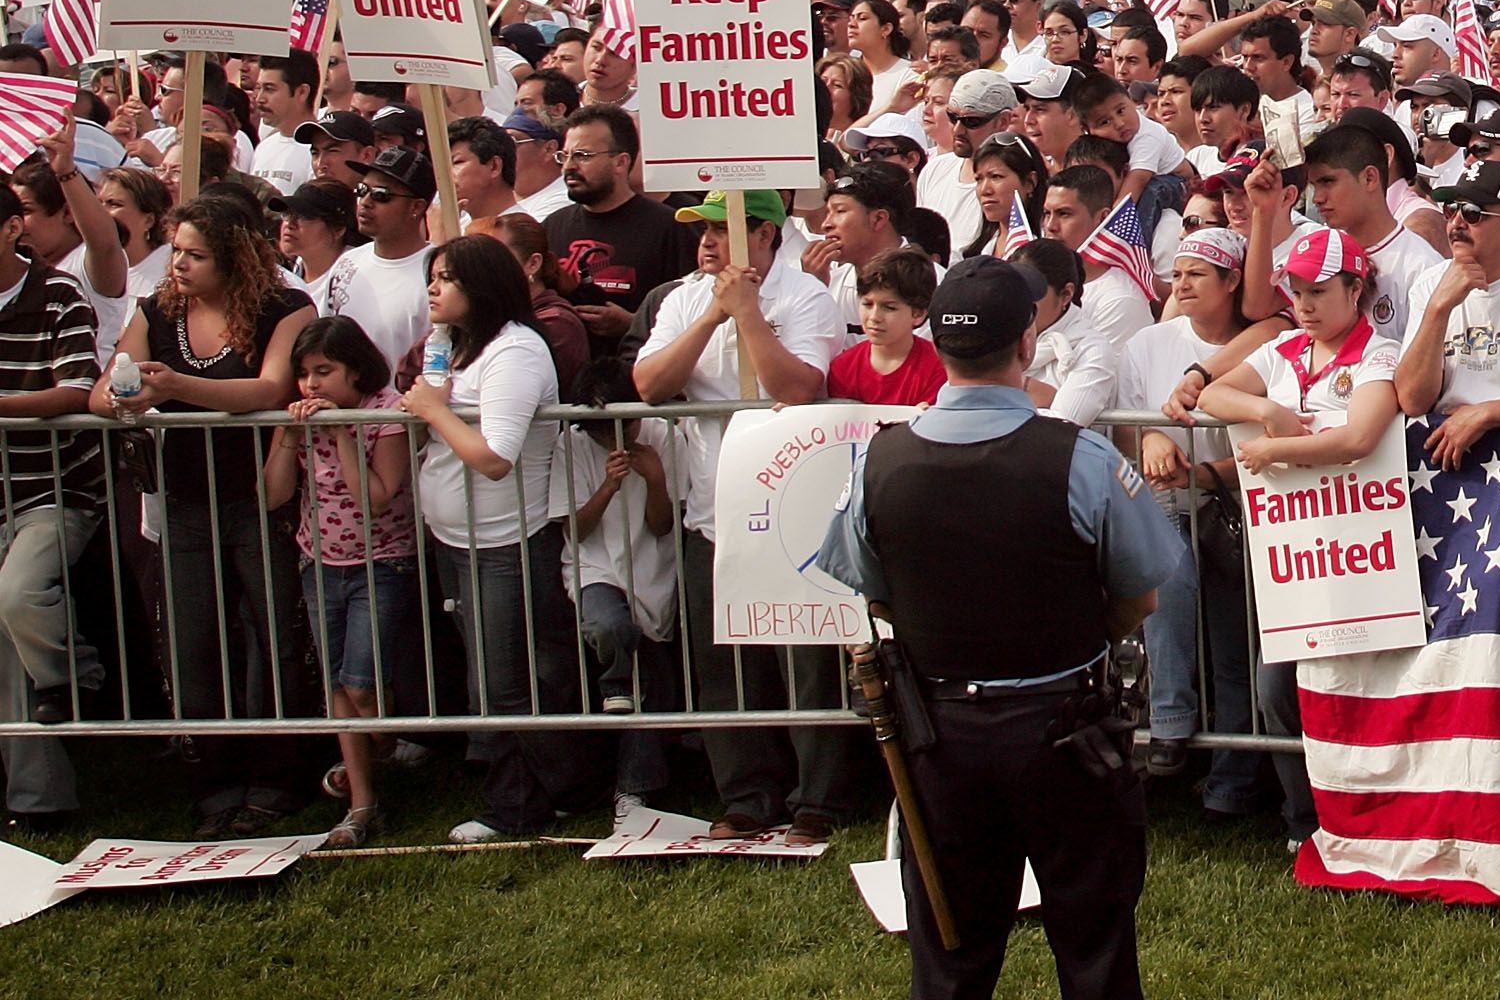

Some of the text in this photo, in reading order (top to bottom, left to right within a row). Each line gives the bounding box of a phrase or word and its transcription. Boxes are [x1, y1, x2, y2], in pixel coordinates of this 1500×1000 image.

[639, 20, 809, 63] Families
[660, 78, 795, 119] United
[942, 313, 978, 325] CPD
[748, 420, 879, 532] EL PUEBLO UNI
[1245, 471, 1407, 527] Families
[1268, 529, 1397, 584] United
[727, 602, 861, 639] LIBERTAD
